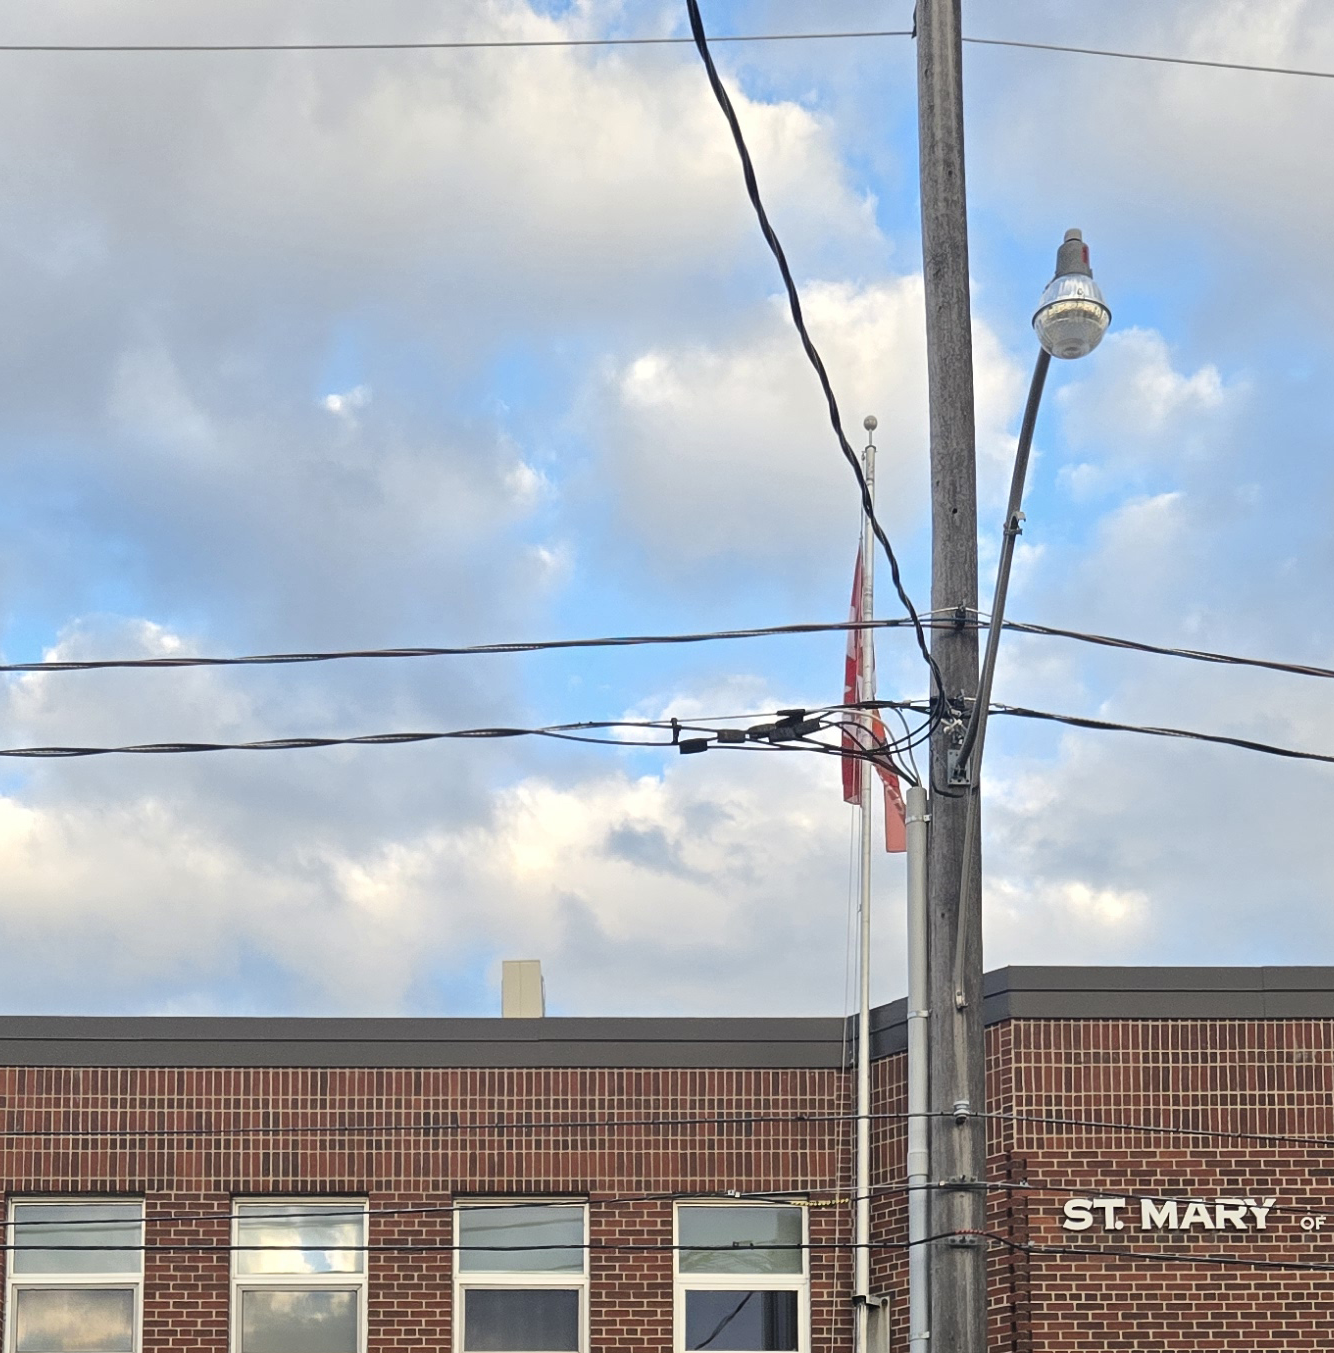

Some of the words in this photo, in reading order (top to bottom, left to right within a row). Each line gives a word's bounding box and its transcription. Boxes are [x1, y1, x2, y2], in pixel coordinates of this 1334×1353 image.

[1062, 1197, 1126, 1231] ST.
[1140, 1197, 1277, 1231] MARY
[1299, 1215, 1327, 1231] OF
